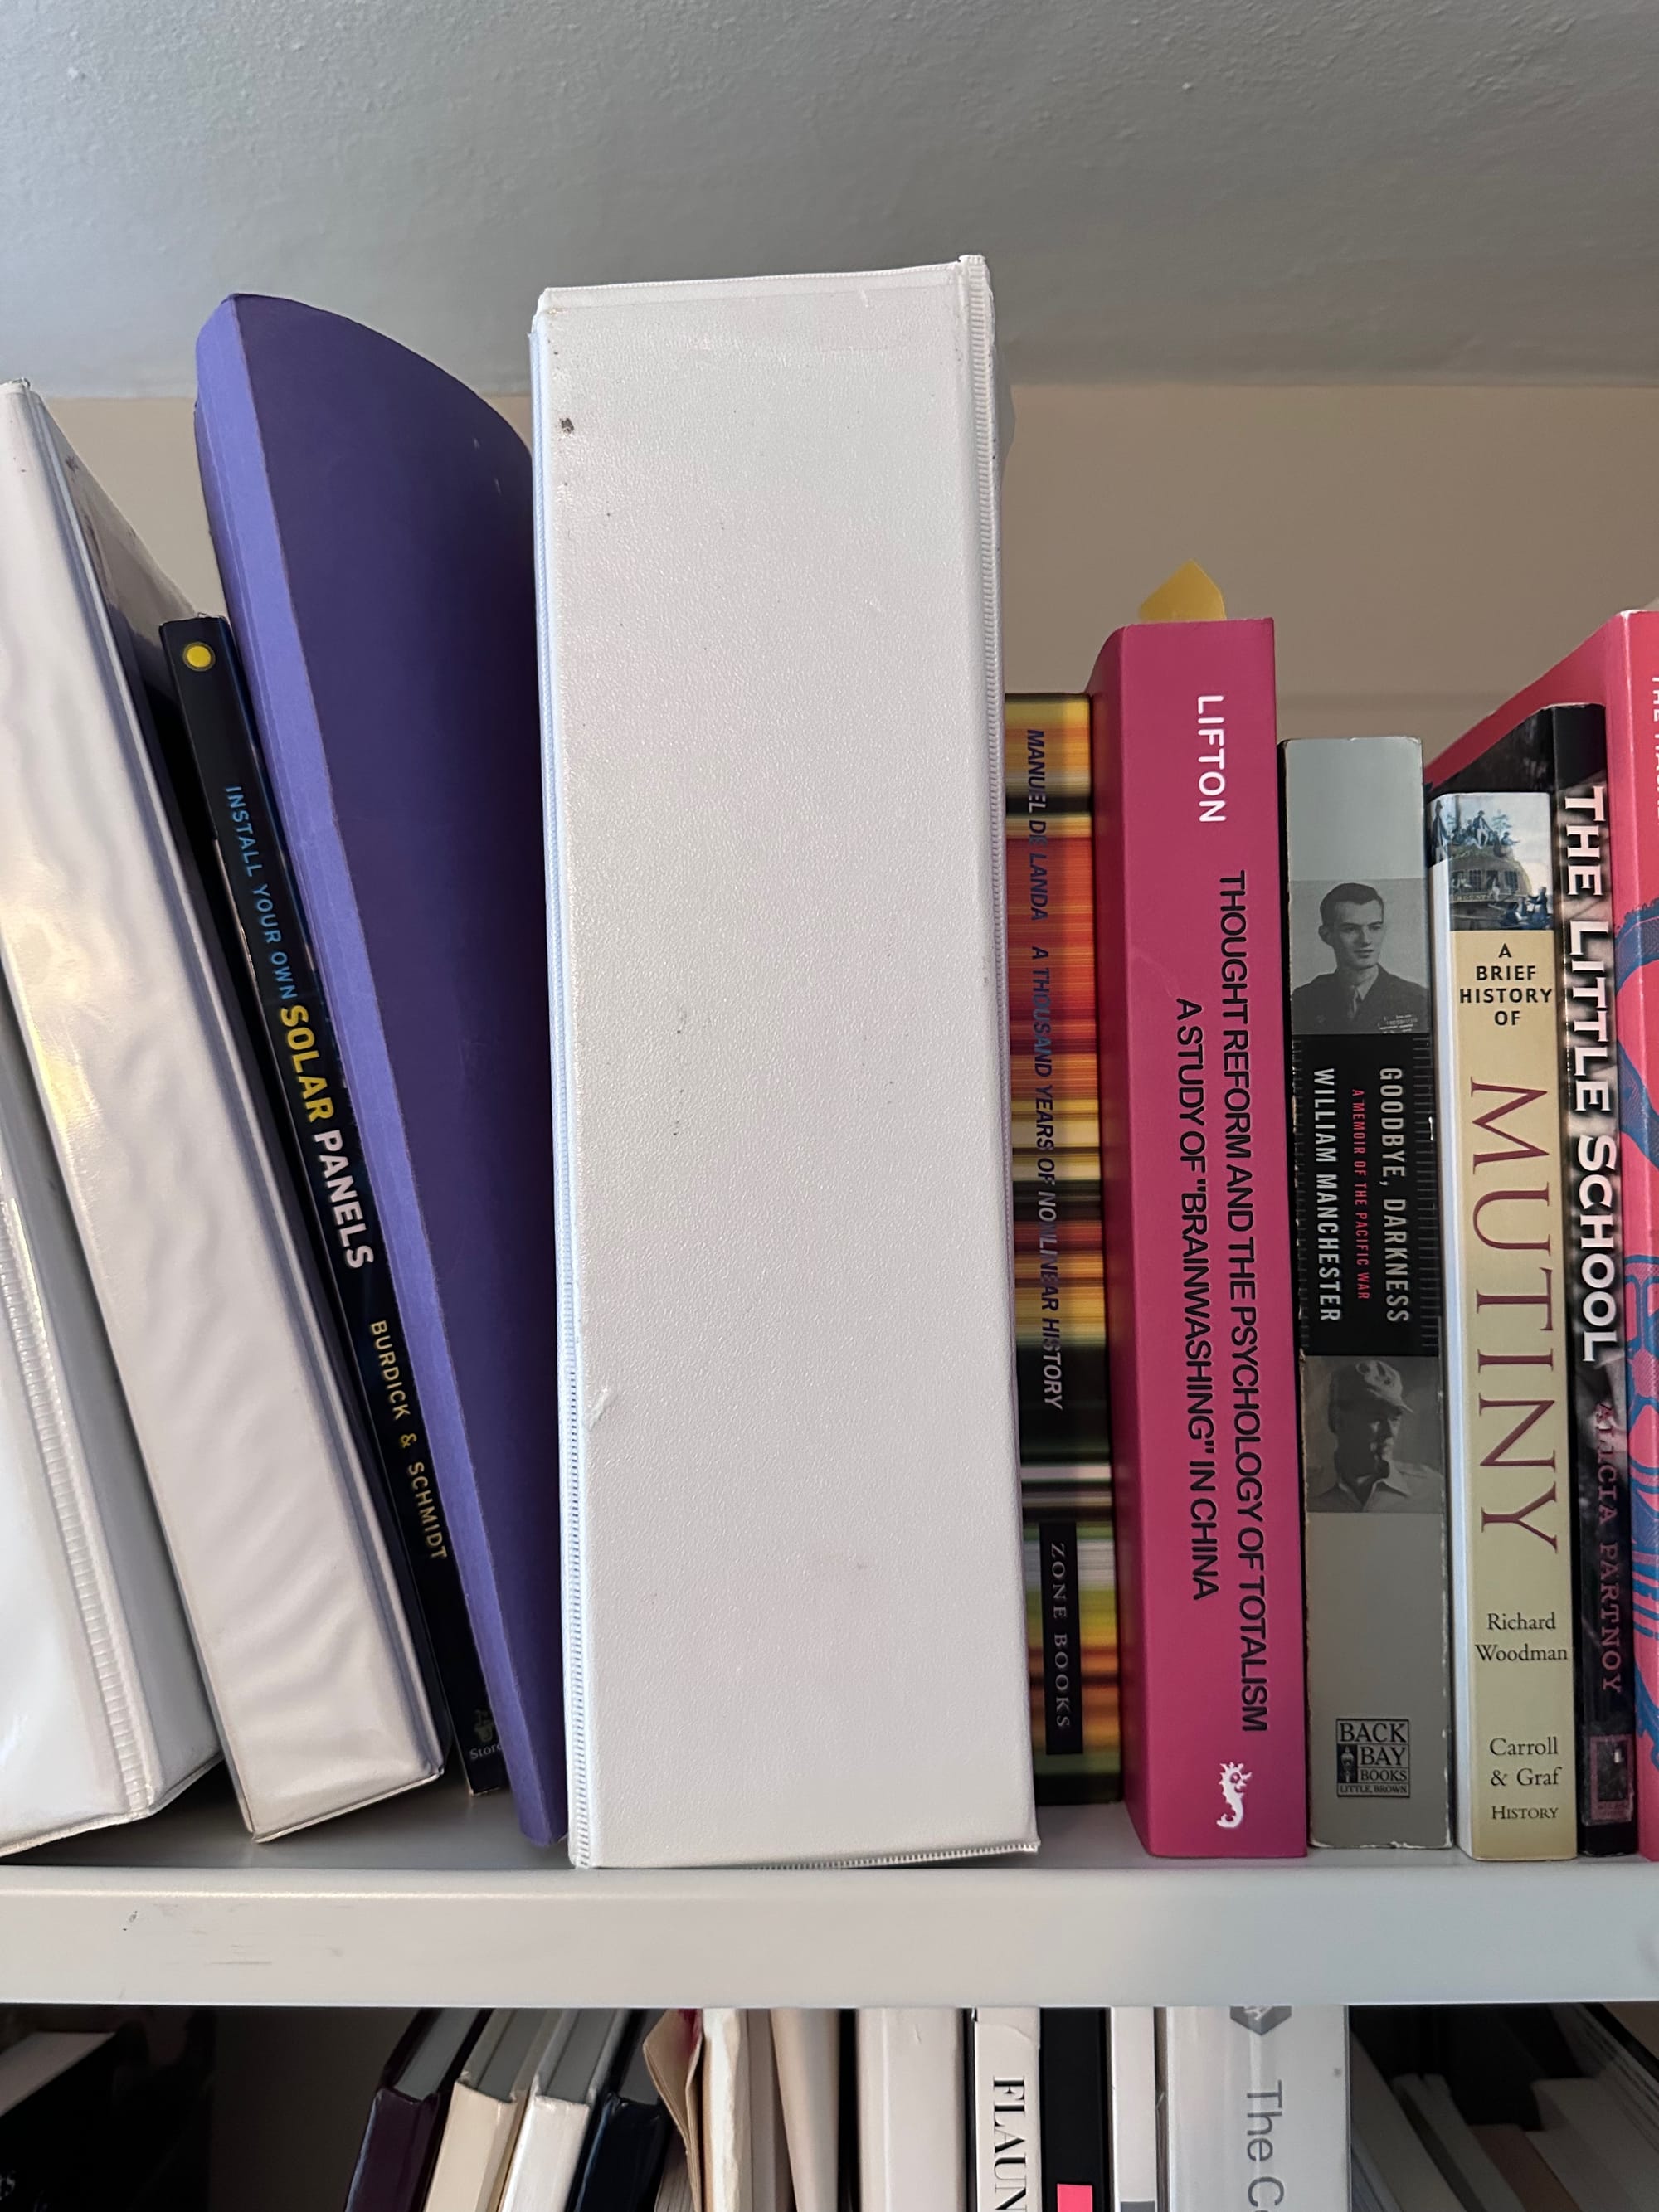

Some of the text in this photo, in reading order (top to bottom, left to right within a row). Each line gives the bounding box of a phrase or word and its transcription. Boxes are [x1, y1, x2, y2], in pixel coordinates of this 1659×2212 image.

[1026, 729, 1049, 921] MANUEL DE LANDA
[1196, 694, 1227, 823] LIFTON
[1459, 988, 1553, 1003] HISTORY
[1476, 965, 1536, 980] BRIEF
[1498, 942, 1512, 958] A
[224, 785, 374, 1269] INSTALL YOUR OWN SOLAR PANELS
[1494, 1010, 1520, 1025] OF
[1564, 785, 1621, 1363] THE LITTLE SCHOOL
[1031, 946, 1063, 1410] A THOUSAND YEARS OF NONLINEAR HISTORY
[1313, 1068, 1341, 1321] WILLIAM MANCHESTER
[1351, 1088, 1370, 1300] A MEMOIR OF THE PACIFIC WAR
[1379, 1067, 1409, 1322] GOODBYE, DARKNESS
[1176, 997, 1219, 1602] A STUDY OF "BRAINWASHING" IN CHINA
[1219, 869, 1268, 1733] THOUGHT REFORM AND THE PSYCHOLOGY OF TOTALISM
[1470, 1076, 1560, 1554] MUTINY
[370, 1319, 449, 1561] BURDICK & SCHMIDT
[1596, 1403, 1623, 1694] ALICIA PARTNOY
[1049, 1542, 1071, 1728] ZONE BOOKS
[1475, 1642, 1569, 1662] Woodman
[1486, 1611, 1557, 1631] Richard
[1339, 1722, 1408, 1743] BACK
[1360, 1745, 1406, 1766] BAY
[1360, 1768, 1408, 1782] BOOKS
[1374, 1784, 1408, 1794] BROWN
[1489, 1736, 1559, 1757] Carroll
[1490, 1766, 1563, 1787] & Graf
[1246, 2078, 1285, 2212] The C
